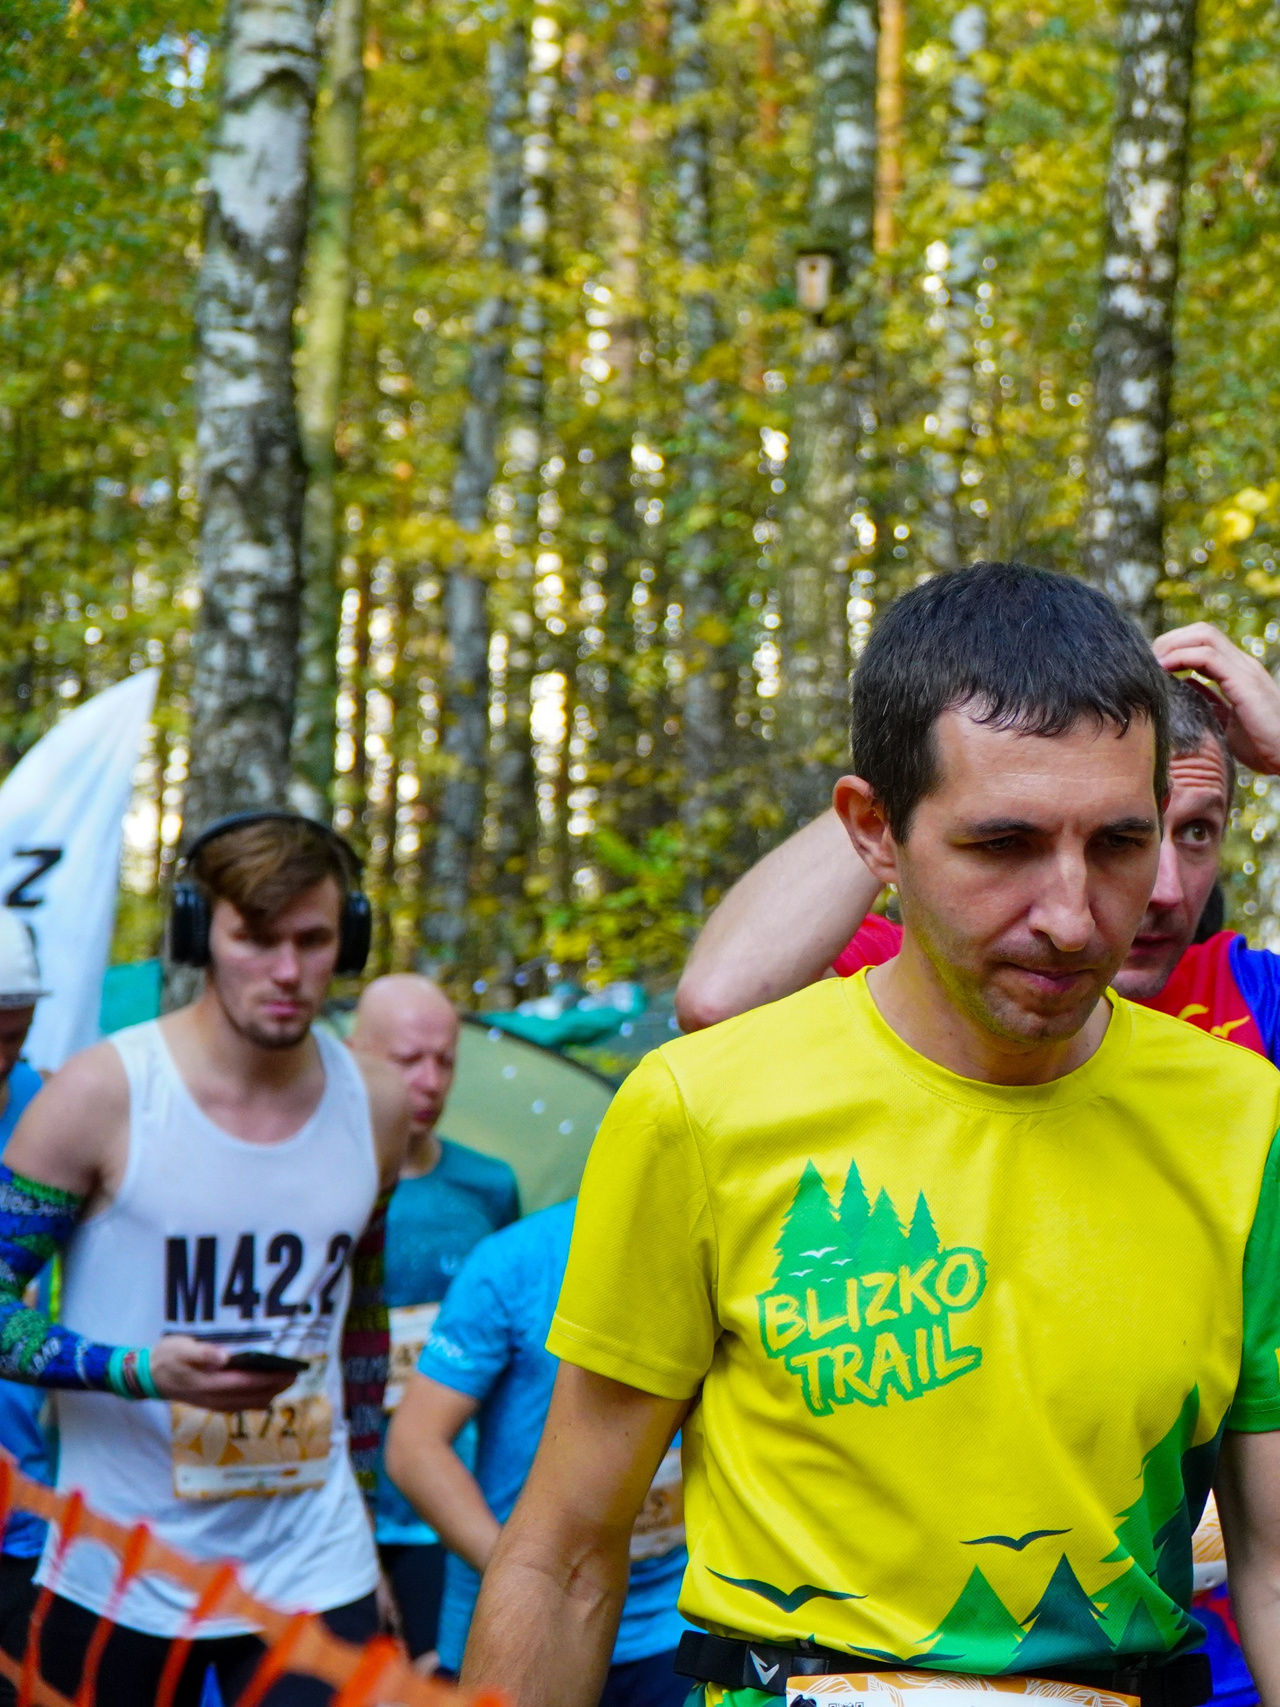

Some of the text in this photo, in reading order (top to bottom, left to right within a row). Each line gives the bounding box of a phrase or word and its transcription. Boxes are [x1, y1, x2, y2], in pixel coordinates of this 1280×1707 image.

[165, 1233, 352, 1322] M42.2
[764, 1253, 980, 1351] BLIZKO
[790, 1325, 977, 1411] TRAIL
